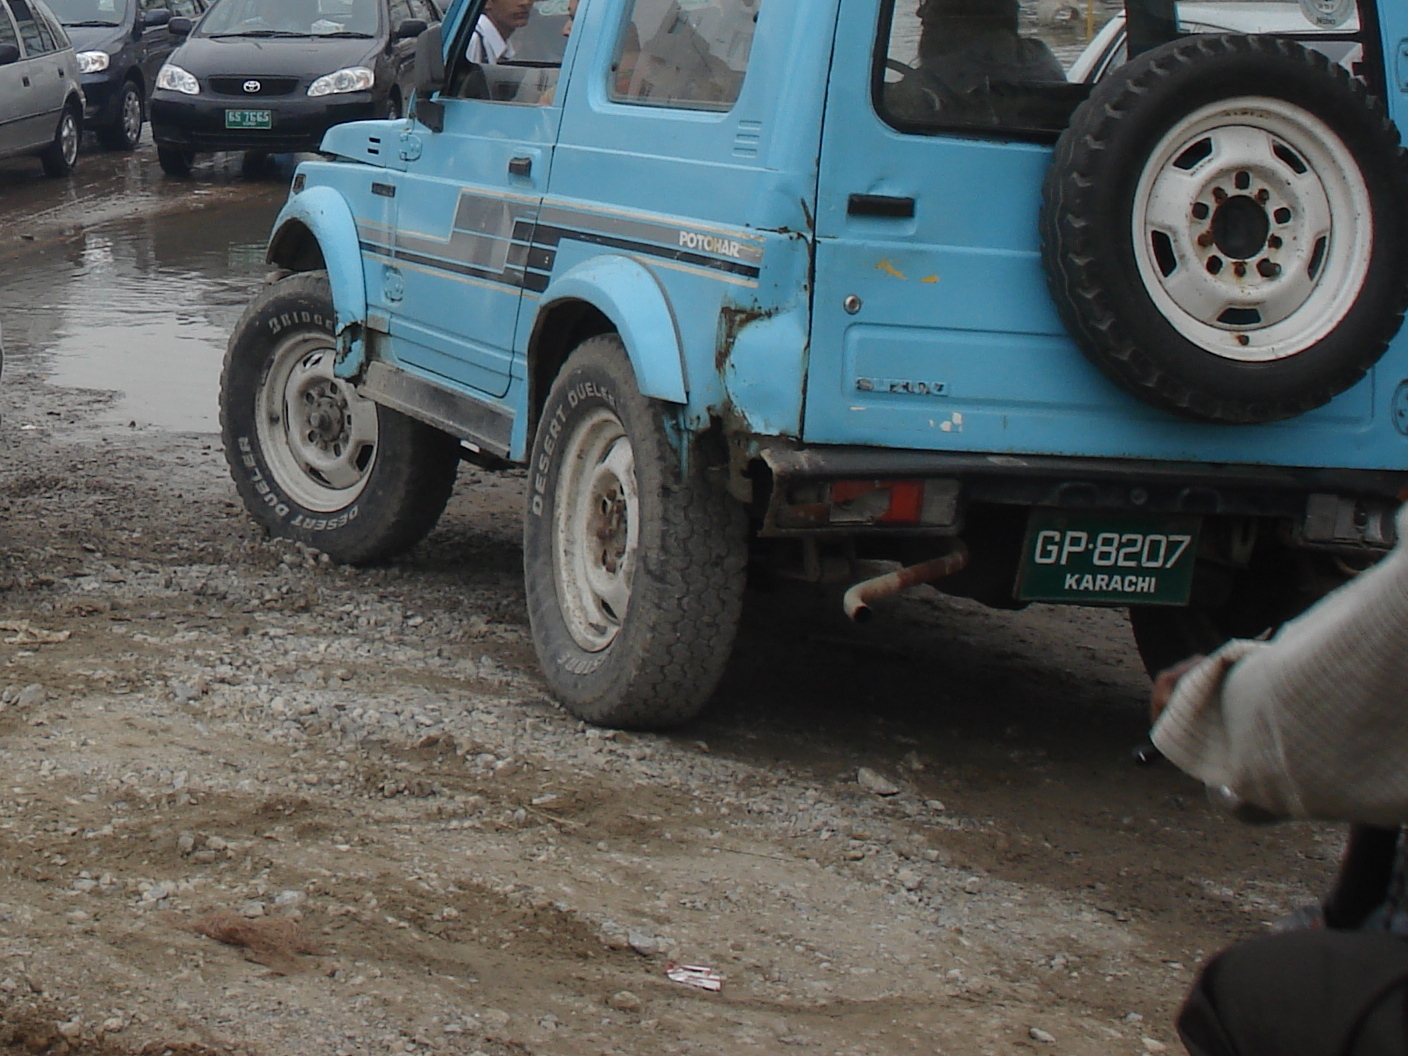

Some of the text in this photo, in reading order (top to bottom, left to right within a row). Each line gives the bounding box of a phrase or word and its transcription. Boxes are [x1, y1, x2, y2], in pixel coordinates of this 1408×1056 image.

[679, 230, 740, 258] POTOHAR
[237, 436, 359, 531] DESERT DUELER
[532, 408, 567, 516] DESERT
[1064, 573, 1156, 593] KARACHI
